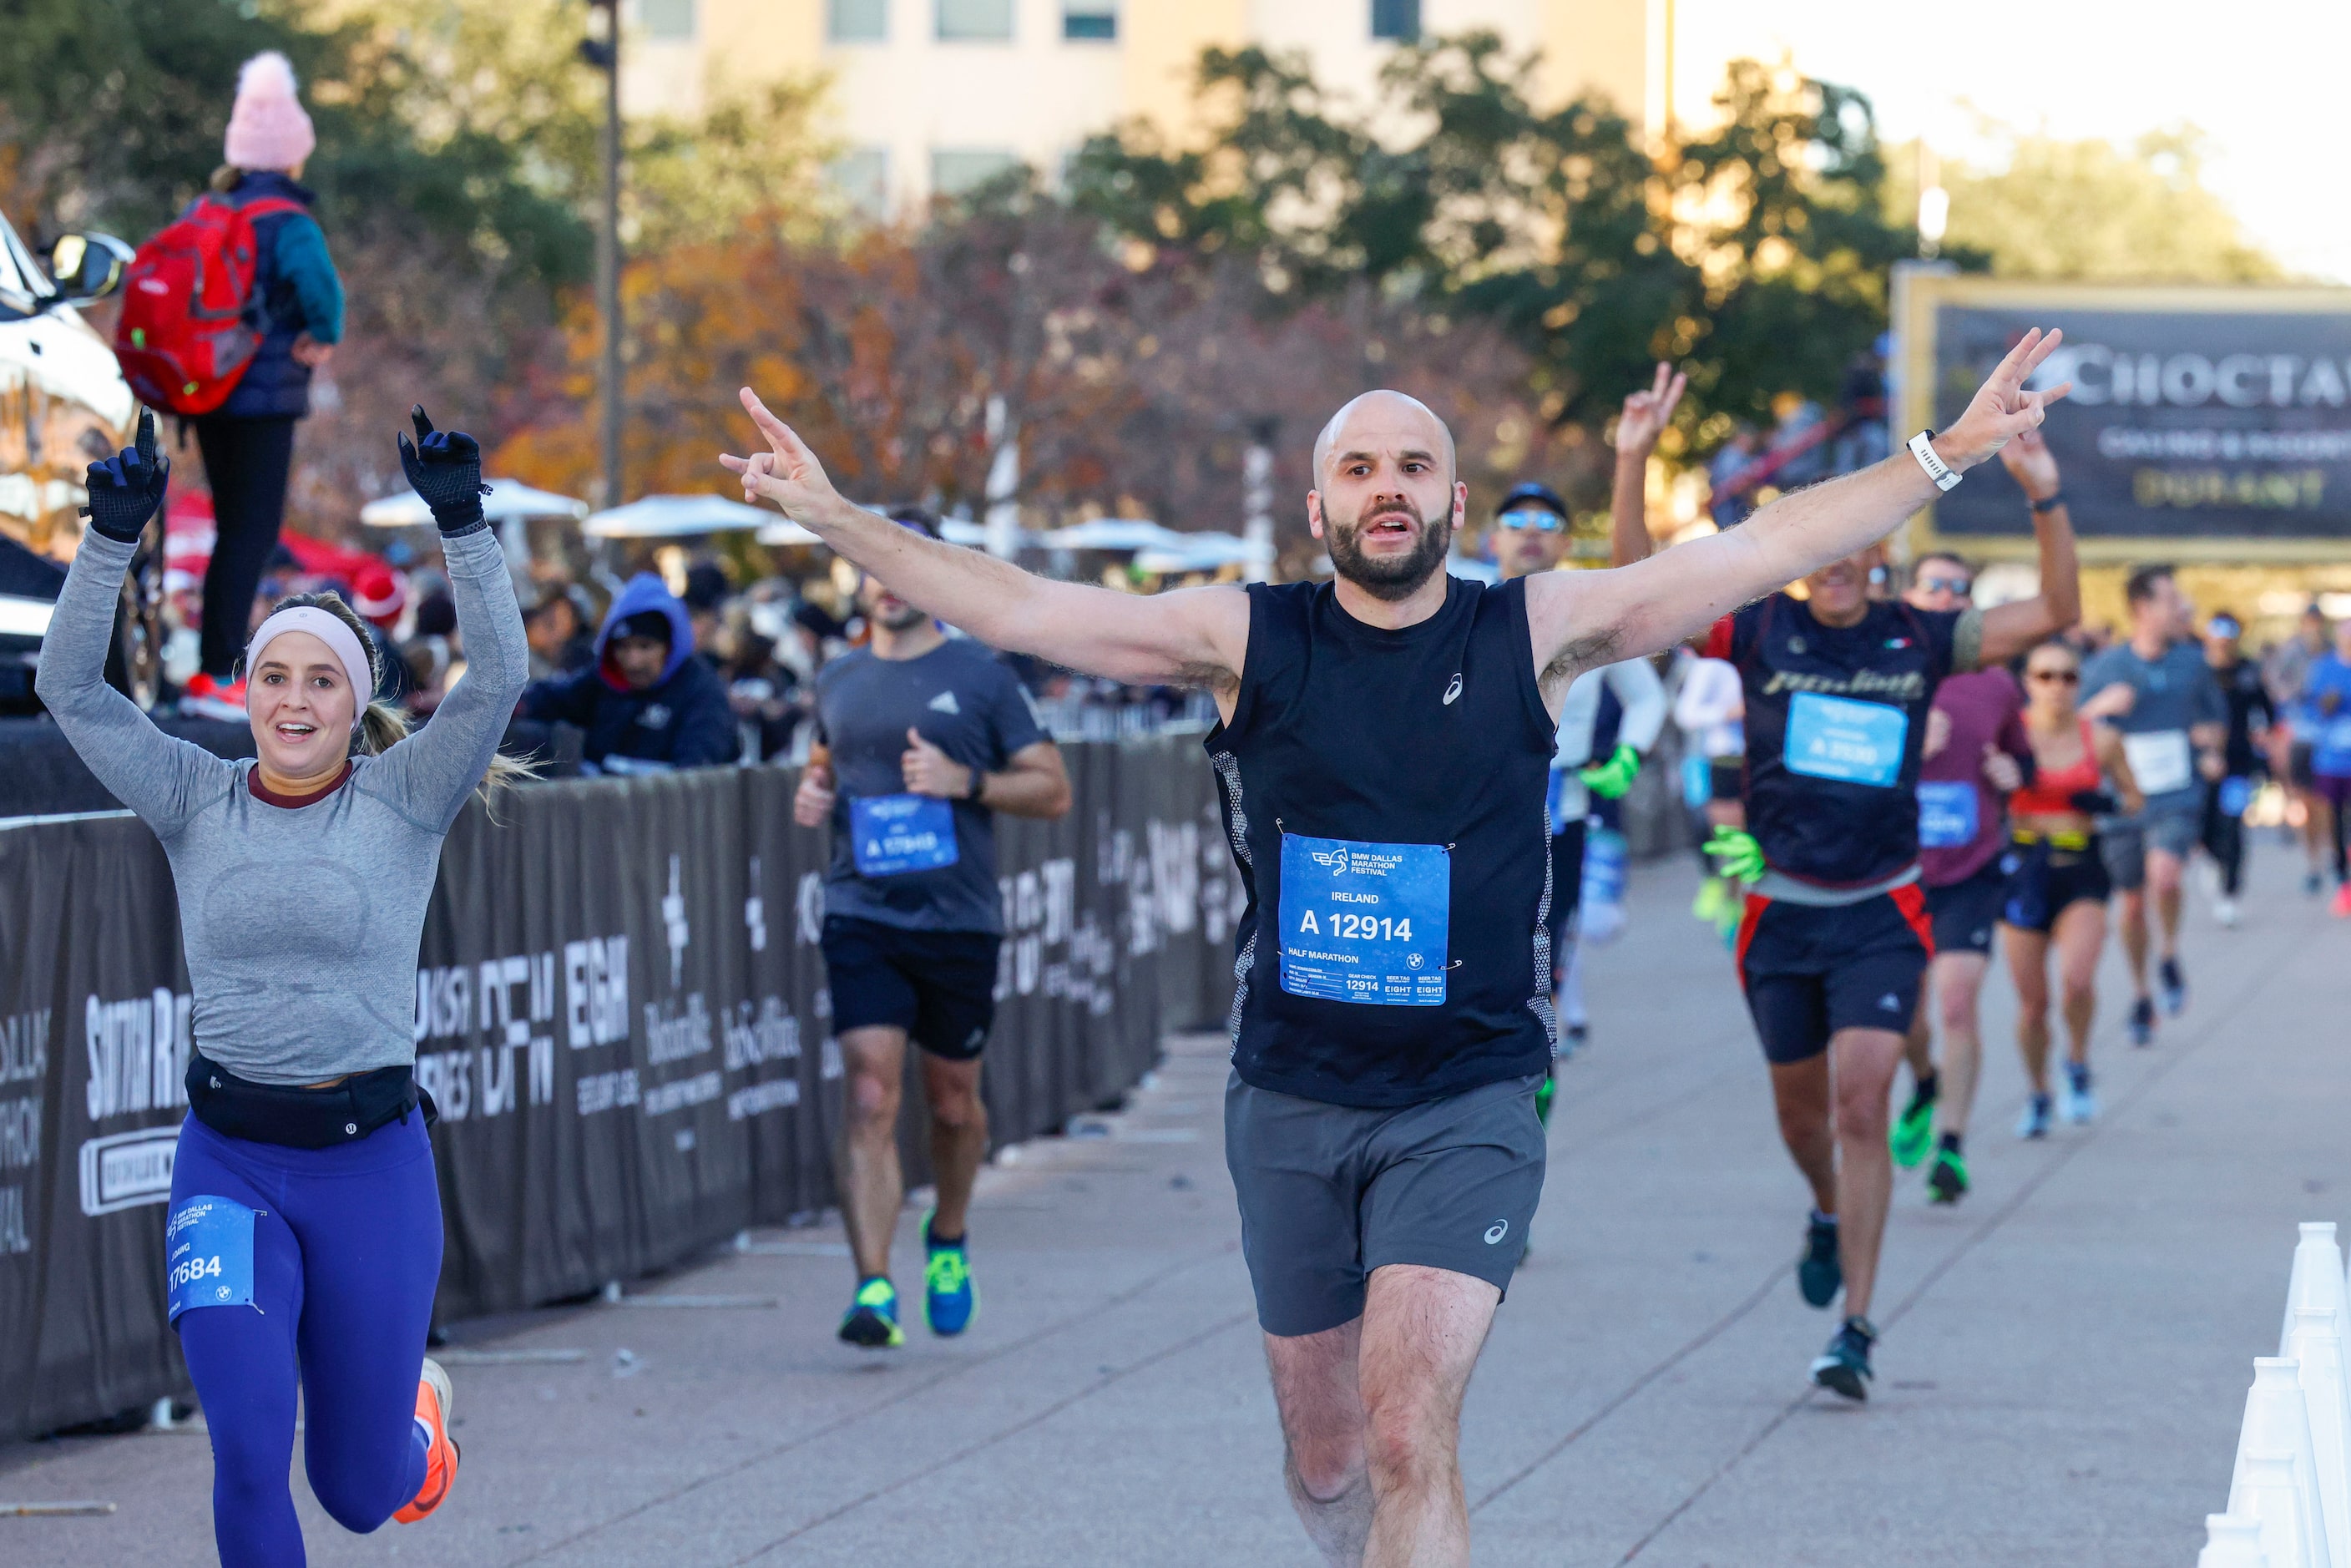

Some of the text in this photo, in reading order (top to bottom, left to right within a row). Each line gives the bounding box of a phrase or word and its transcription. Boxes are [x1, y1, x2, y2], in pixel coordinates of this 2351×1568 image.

[2065, 343, 2351, 407] CHOCTA
[1351, 852, 1403, 862] BMW DALLAS
[1351, 860, 1395, 869] MARATHON
[1351, 867, 1388, 877] FESTIVAL
[1332, 891, 1379, 904] IRELAND
[1300, 909, 1413, 942] A 12914
[1288, 947, 1359, 964] HALF MARATHON
[1346, 979, 1379, 992] 12914
[187, 1204, 213, 1214] DALLAS
[178, 1210, 206, 1225] MARATHON
[177, 1218, 199, 1232] FESTIVAL
[169, 1256, 222, 1293] 17684
